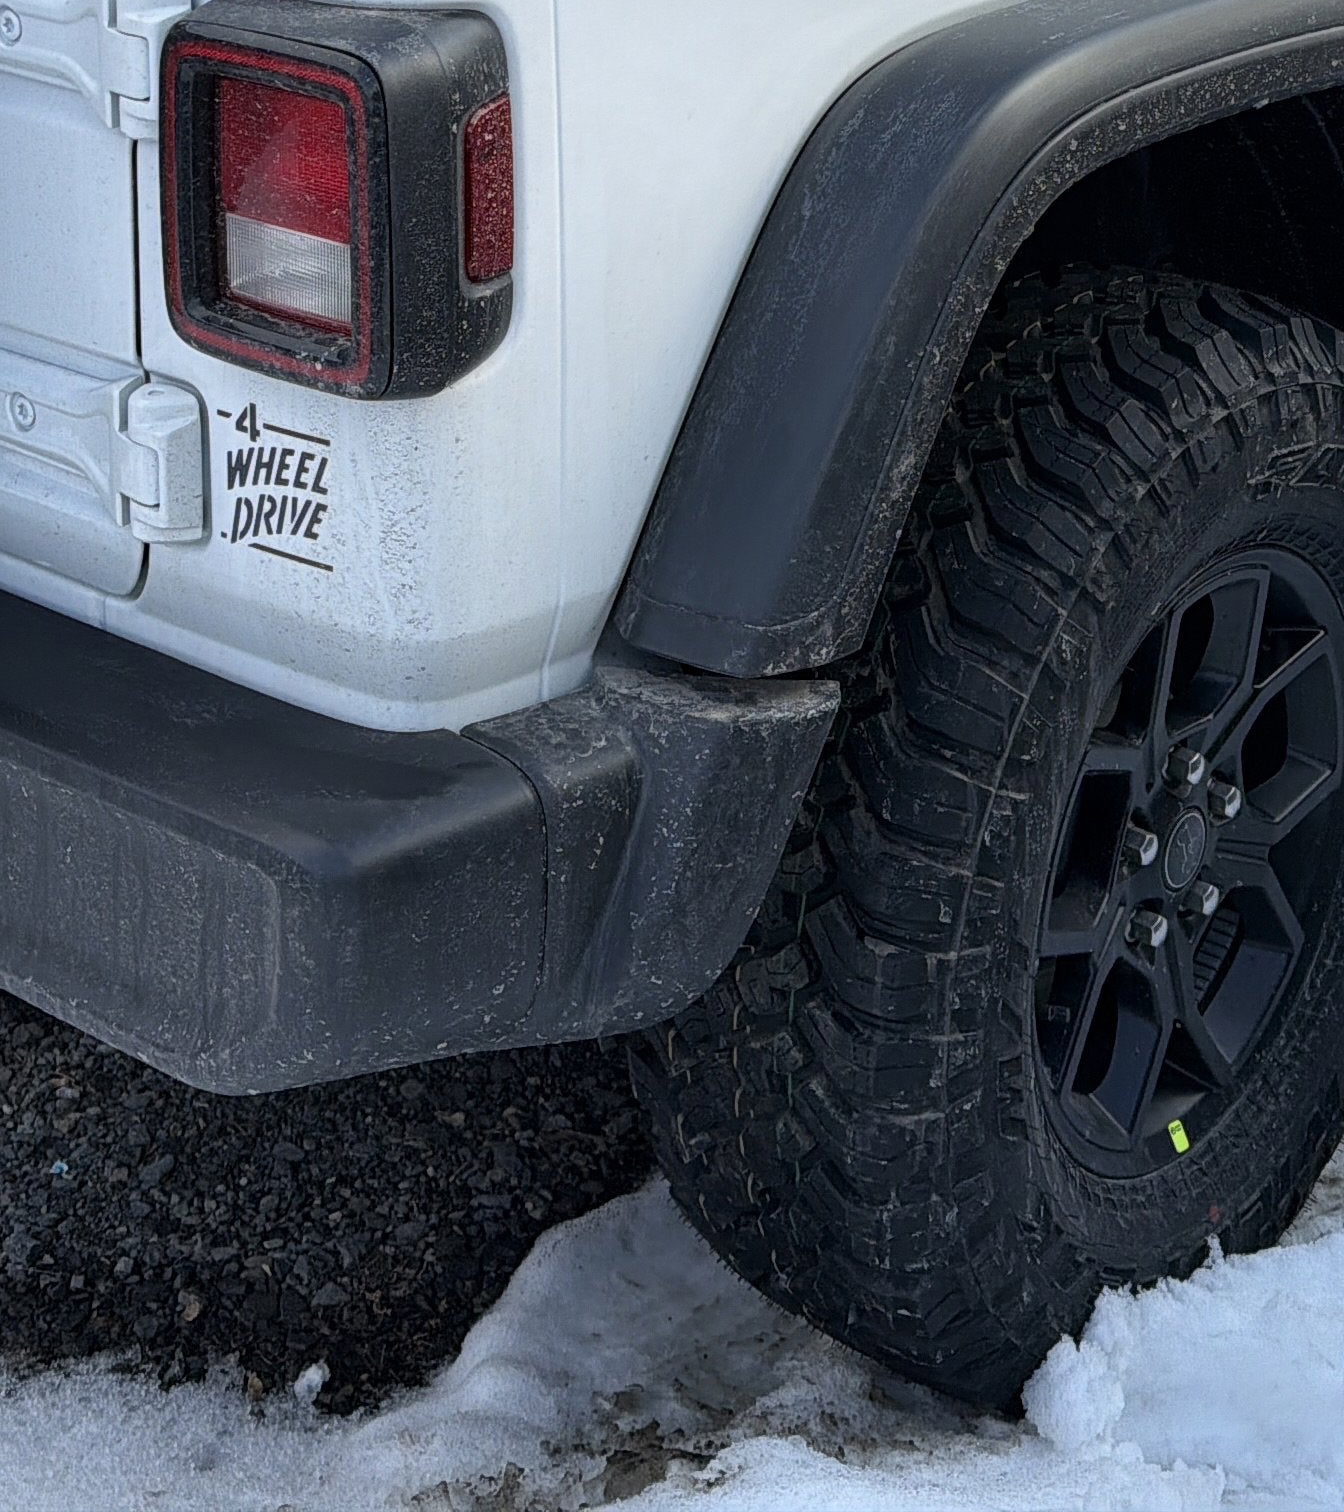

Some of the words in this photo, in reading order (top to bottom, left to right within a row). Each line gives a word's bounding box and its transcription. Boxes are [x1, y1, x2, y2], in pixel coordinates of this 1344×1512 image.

[235, 402, 261, 443] 4
[226, 446, 330, 496] WHEEL
[229, 493, 329, 544] DRIVE
